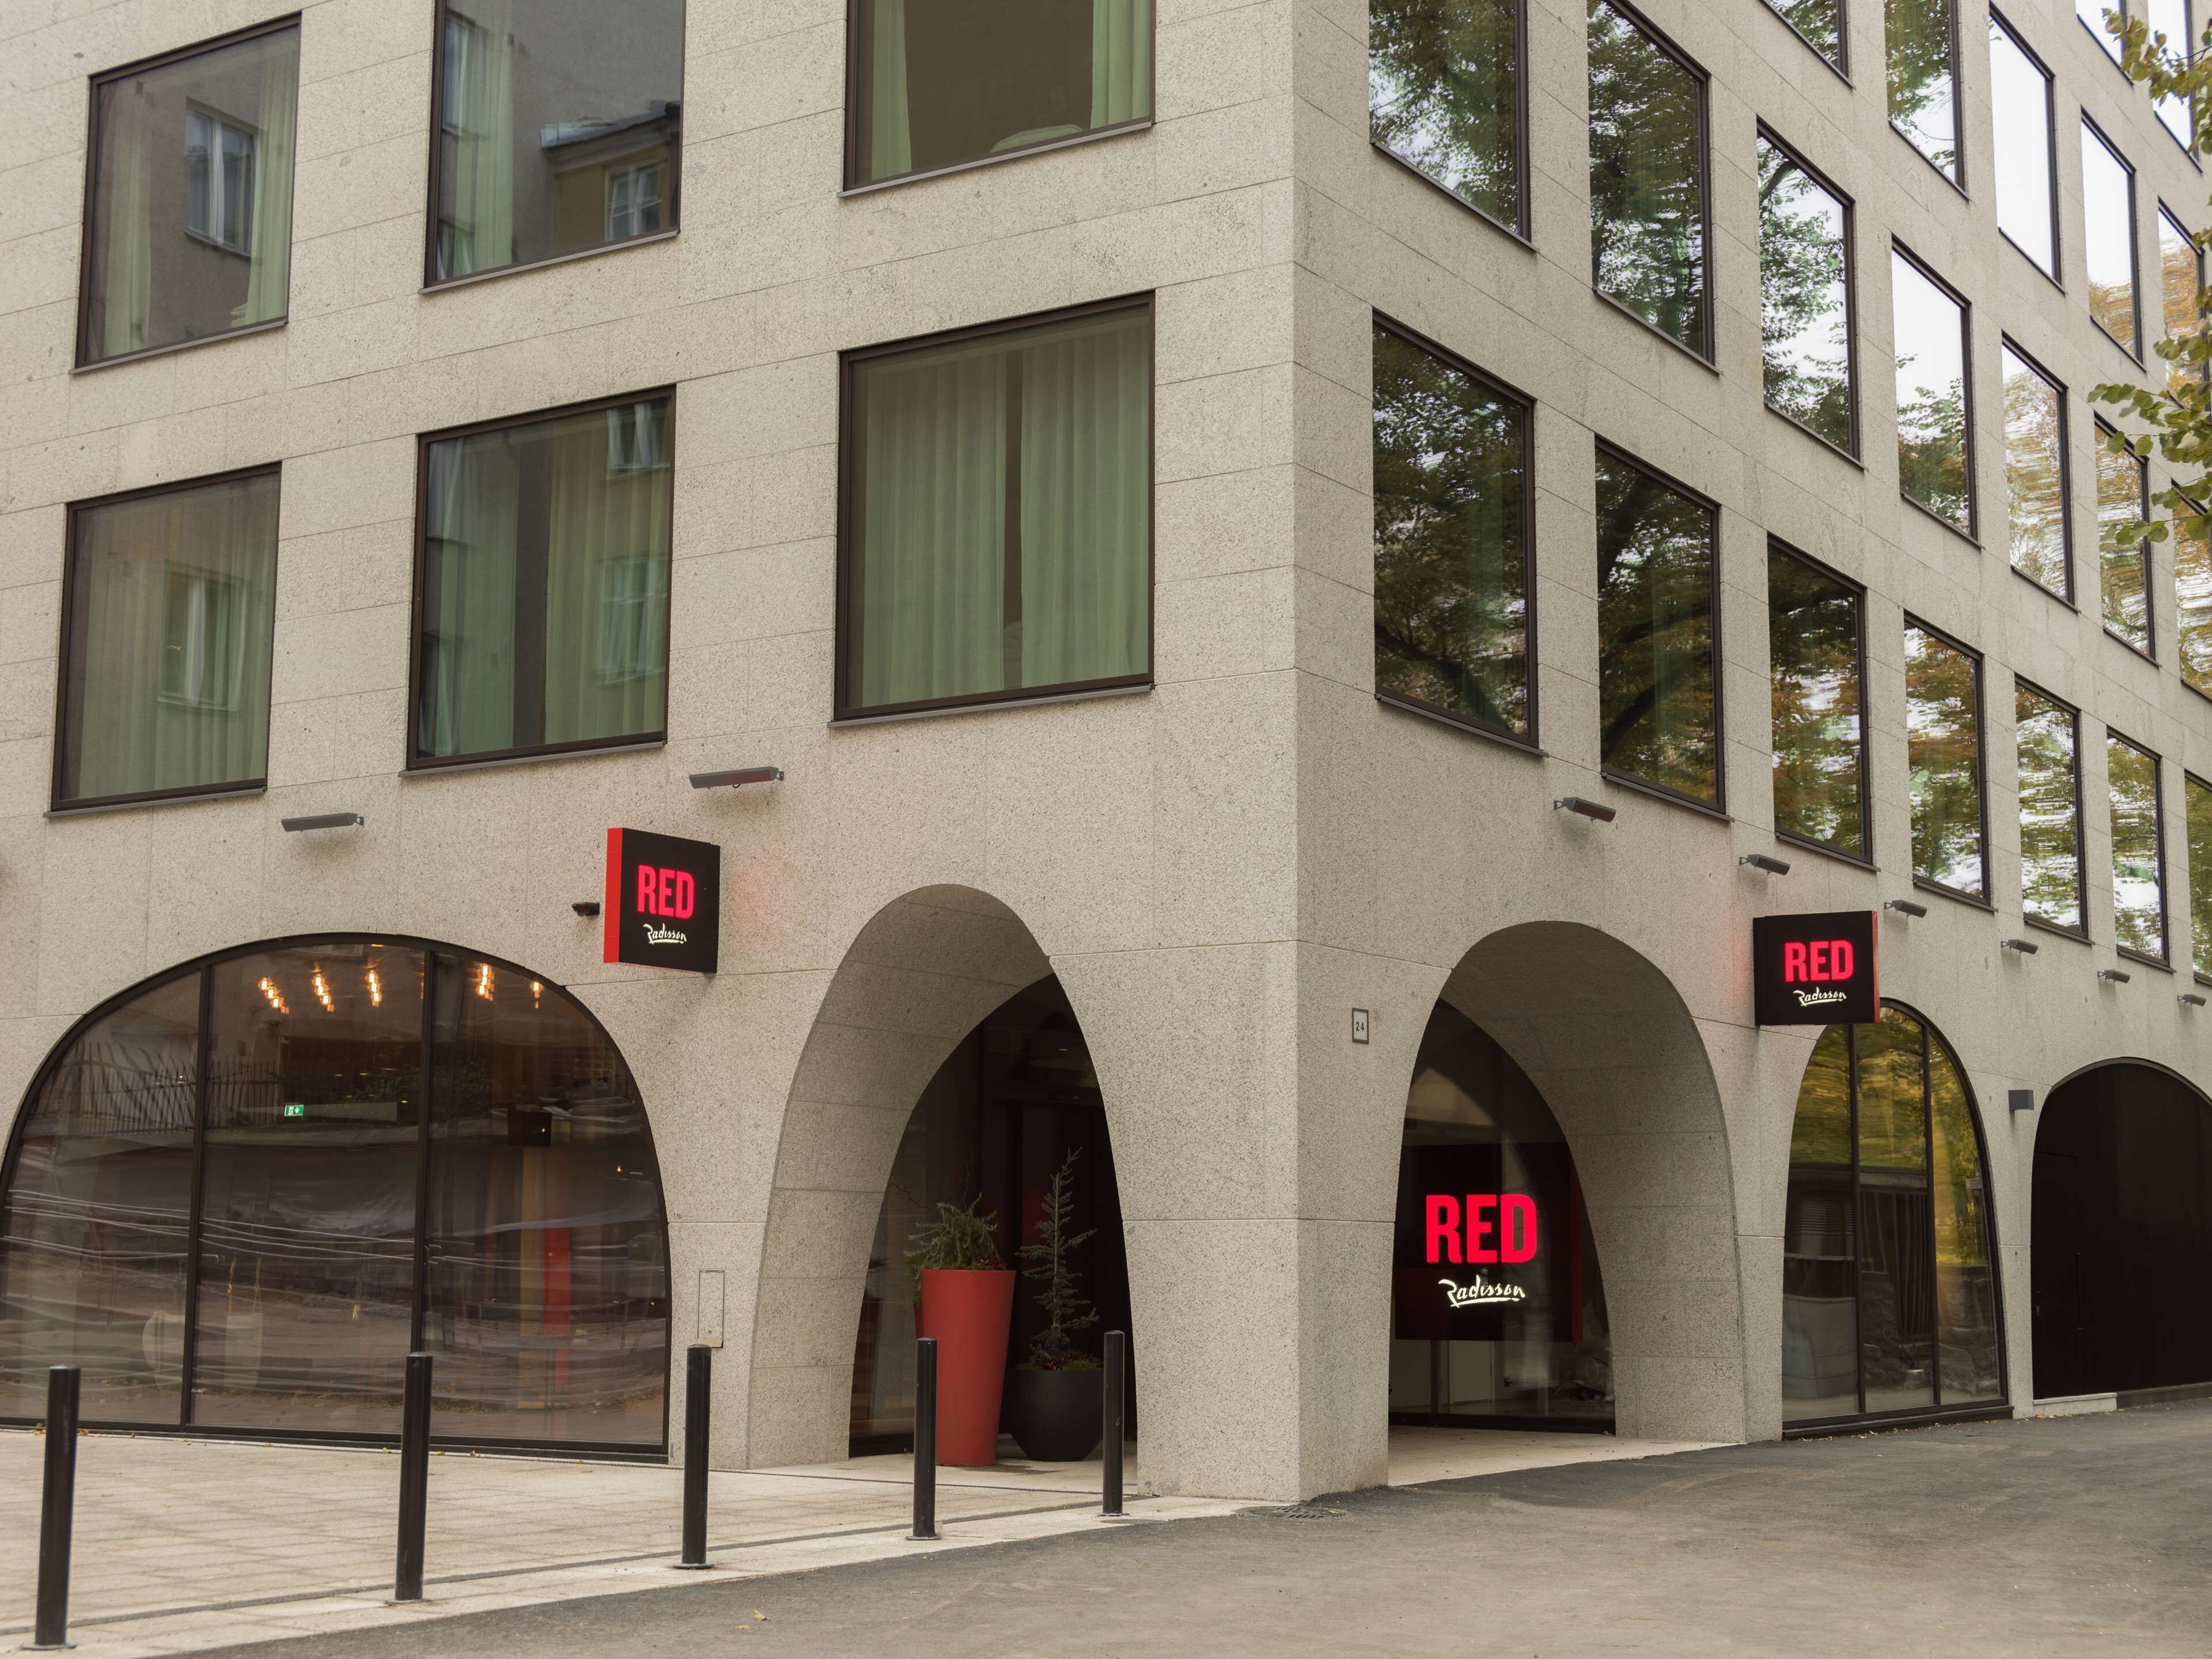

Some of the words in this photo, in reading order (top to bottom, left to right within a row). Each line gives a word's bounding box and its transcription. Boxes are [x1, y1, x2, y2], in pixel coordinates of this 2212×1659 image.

[637, 865, 695, 919] RED
[643, 923, 687, 945] Radisson
[1784, 940, 1854, 982] RED
[1793, 986, 1847, 1007] Radisson
[1355, 1021, 1365, 1032] 24
[1426, 1194, 1537, 1263] RED
[1438, 1274, 1526, 1308] Radisson
